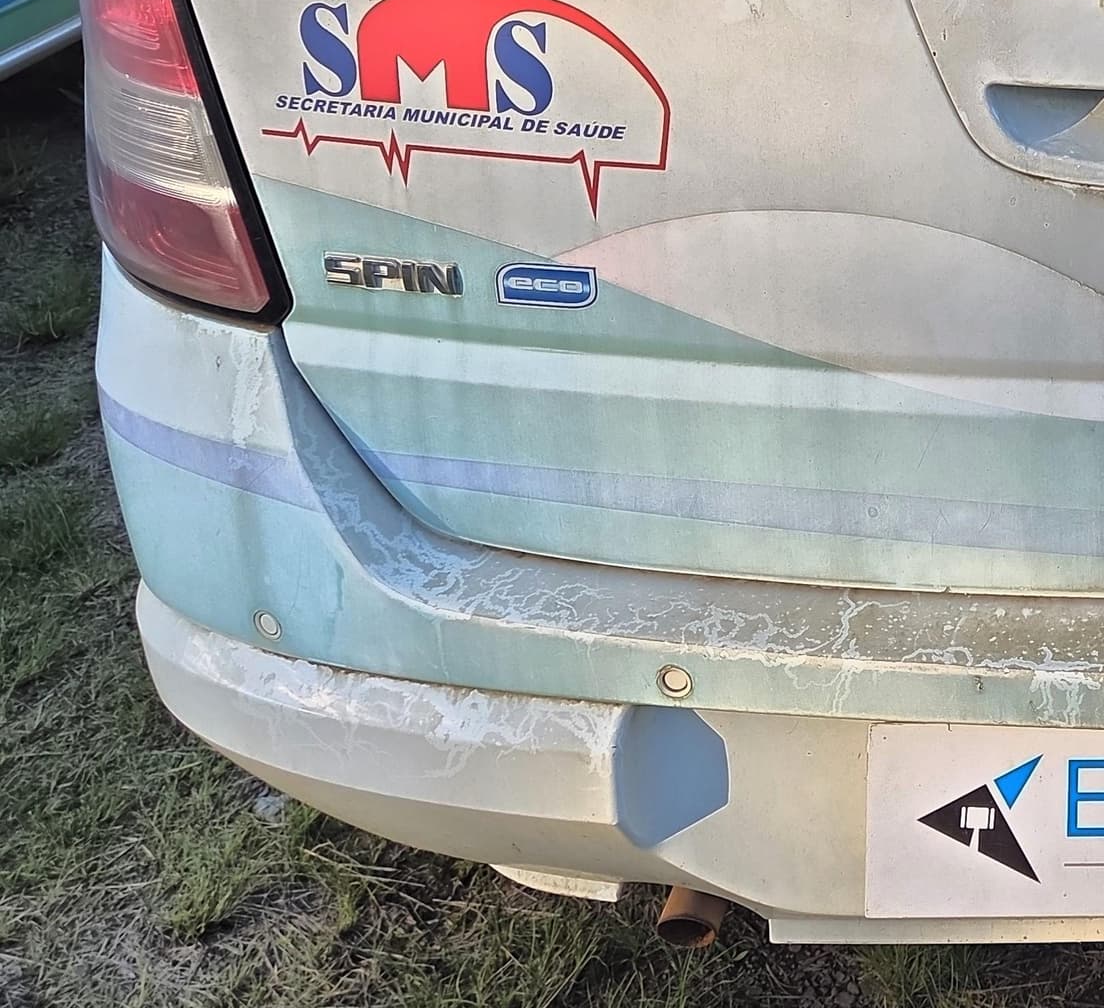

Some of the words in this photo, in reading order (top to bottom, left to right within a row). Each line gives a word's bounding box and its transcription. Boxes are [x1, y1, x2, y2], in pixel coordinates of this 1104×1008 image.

[275, 94, 397, 121] SECRETARIA
[402, 108, 515, 132] MUNICIPAL
[520, 119, 549, 134] DE
[553, 120, 627, 141] SAÚDE
[324, 251, 463, 298] SPIN
